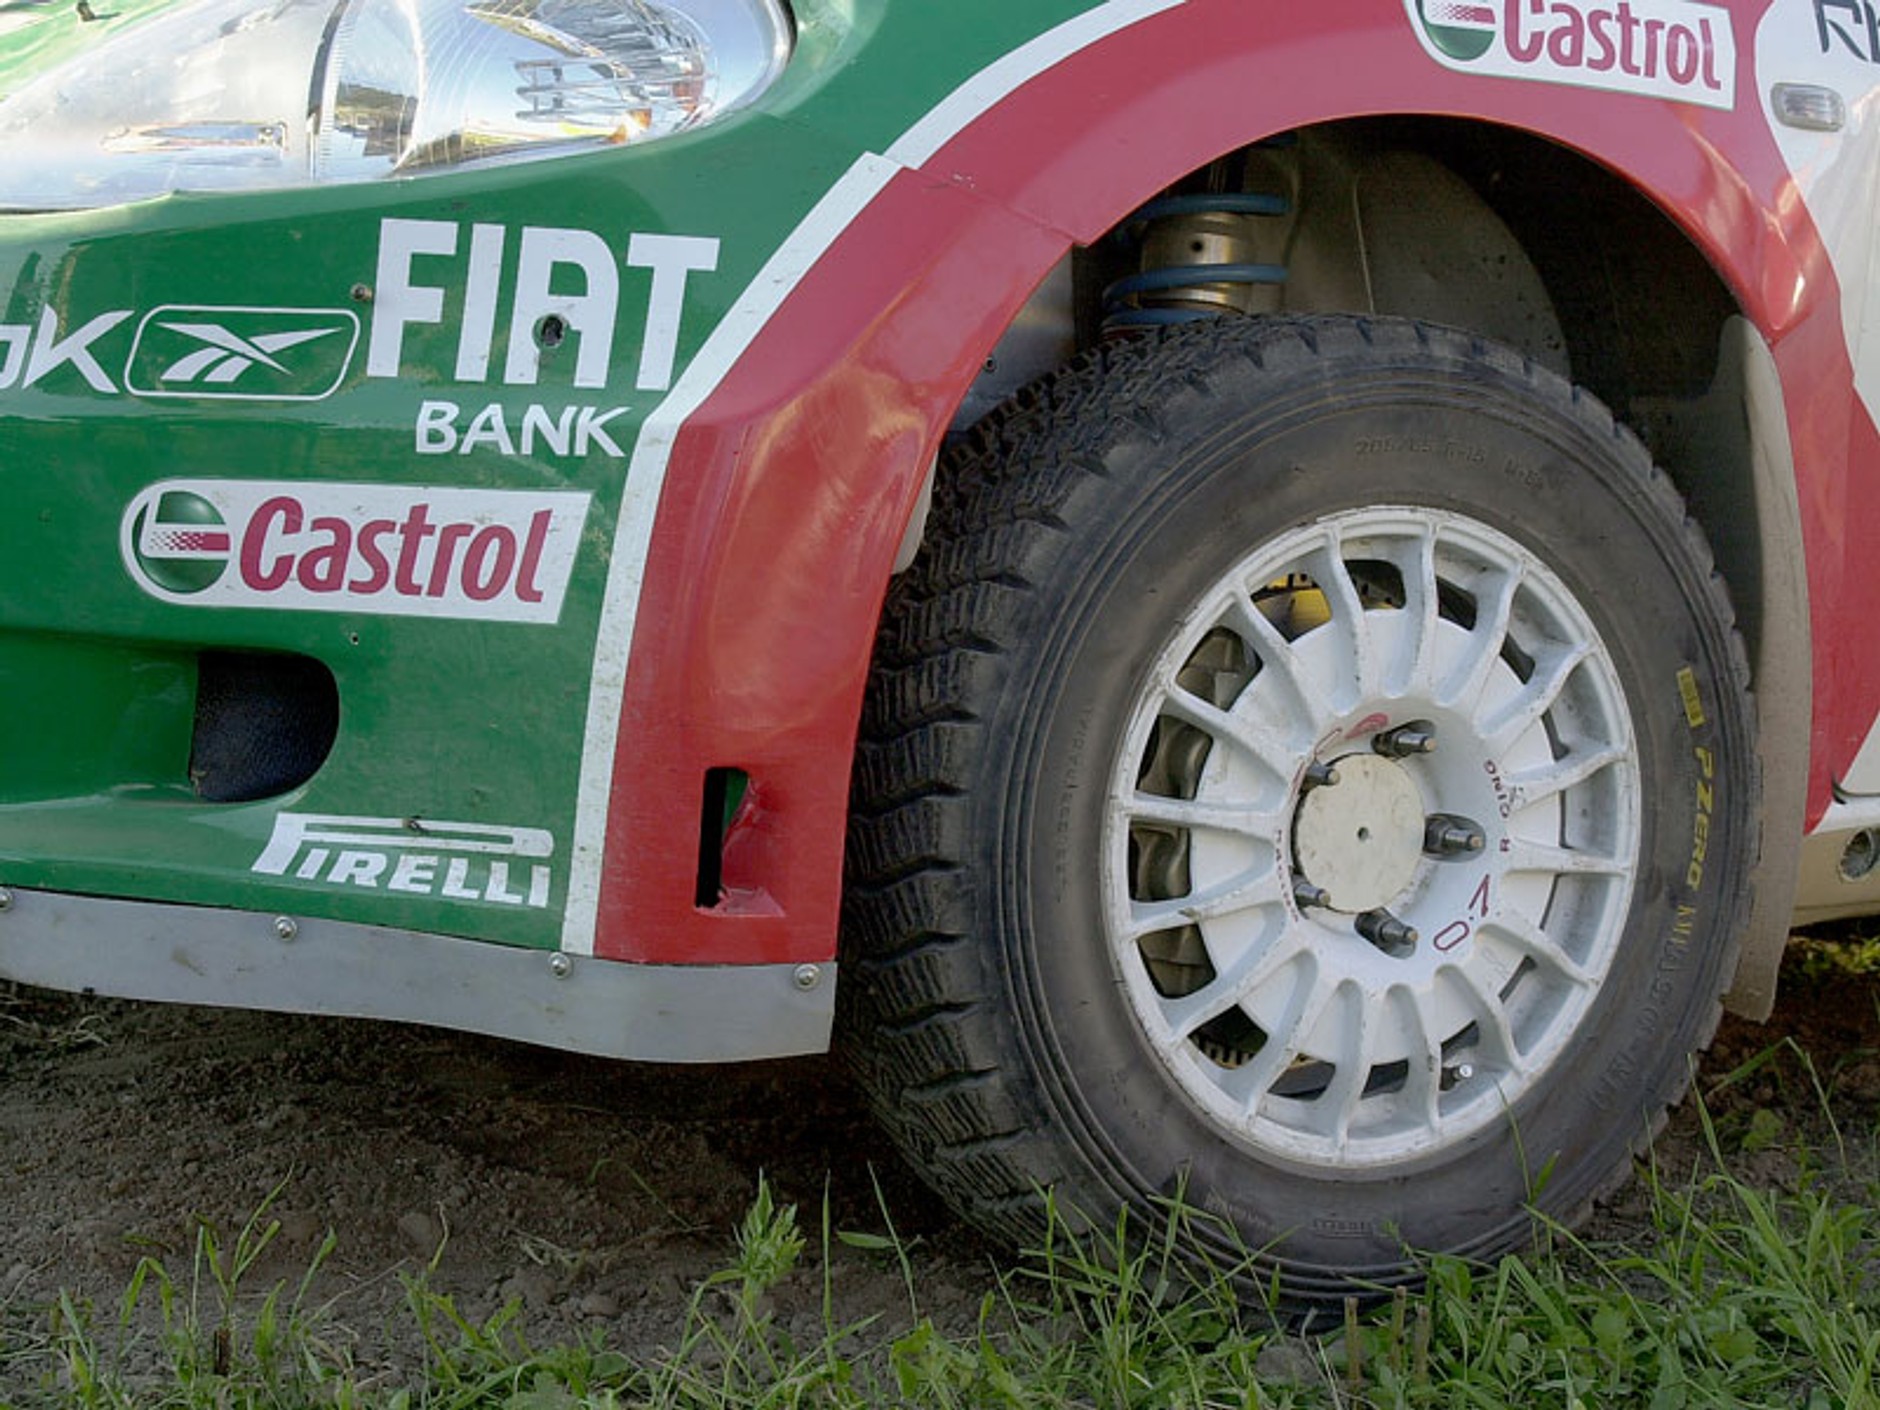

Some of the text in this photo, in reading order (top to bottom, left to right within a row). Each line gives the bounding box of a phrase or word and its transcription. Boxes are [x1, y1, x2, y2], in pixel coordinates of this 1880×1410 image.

[1504, 0, 1721, 91] Castrol
[366, 217, 721, 391] FIAT
[415, 401, 632, 457] BANK
[239, 495, 554, 603] Castrol
[251, 811, 555, 908] PIRELLI
